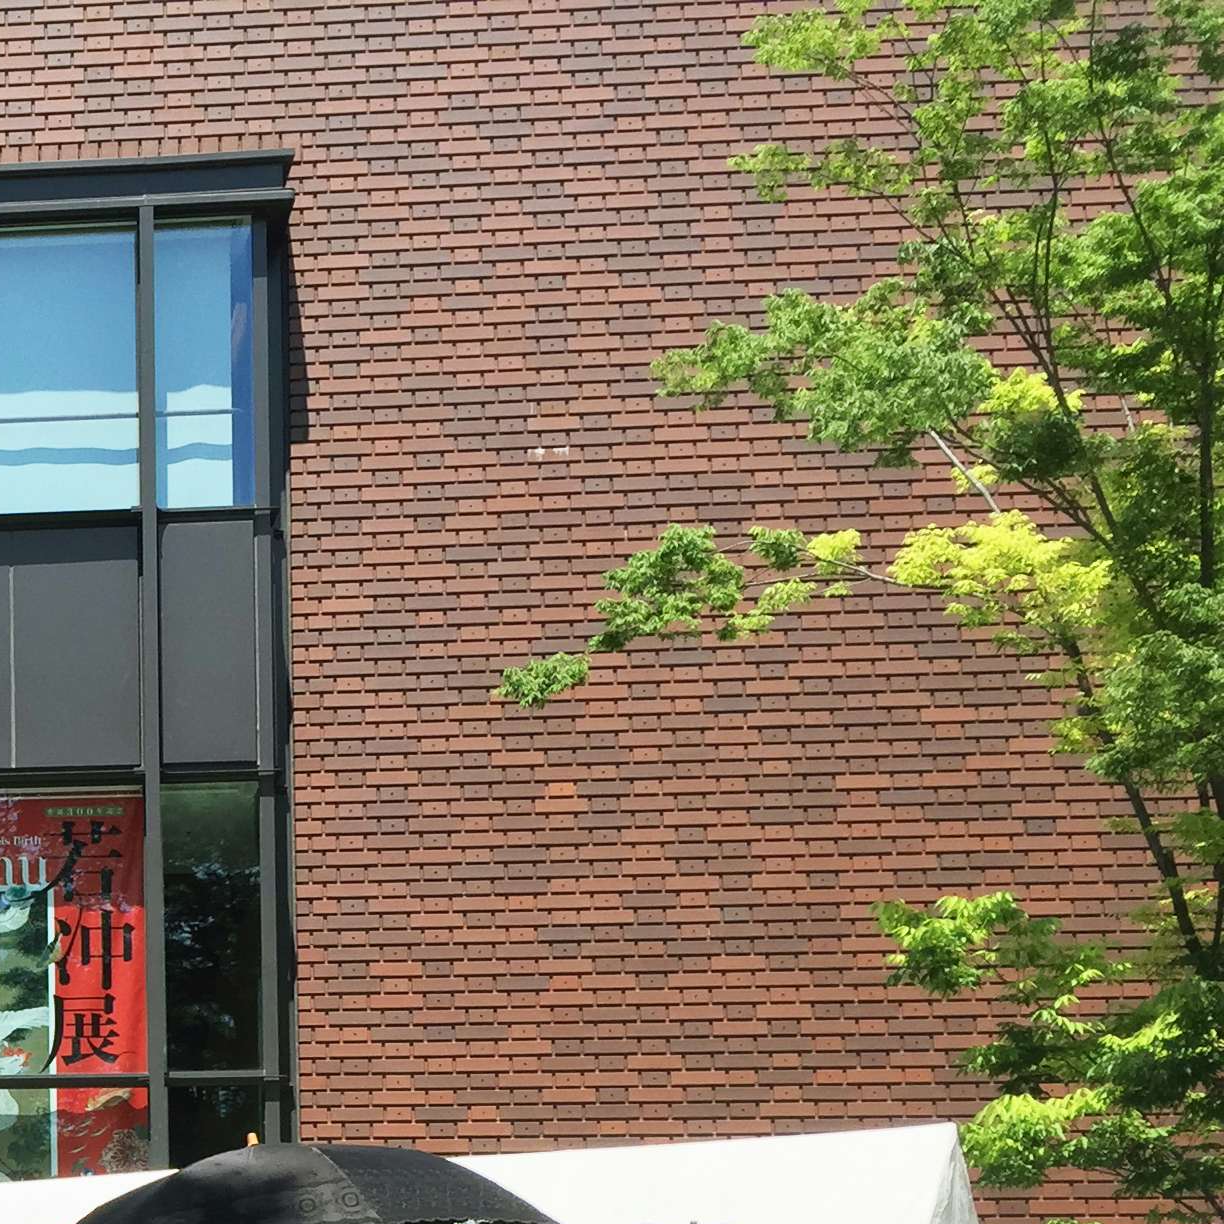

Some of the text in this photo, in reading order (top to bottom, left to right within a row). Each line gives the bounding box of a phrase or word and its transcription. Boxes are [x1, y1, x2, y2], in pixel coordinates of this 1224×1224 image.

[14, 835, 41, 846] Birth
[34, 821, 135, 1073] 若冲展
